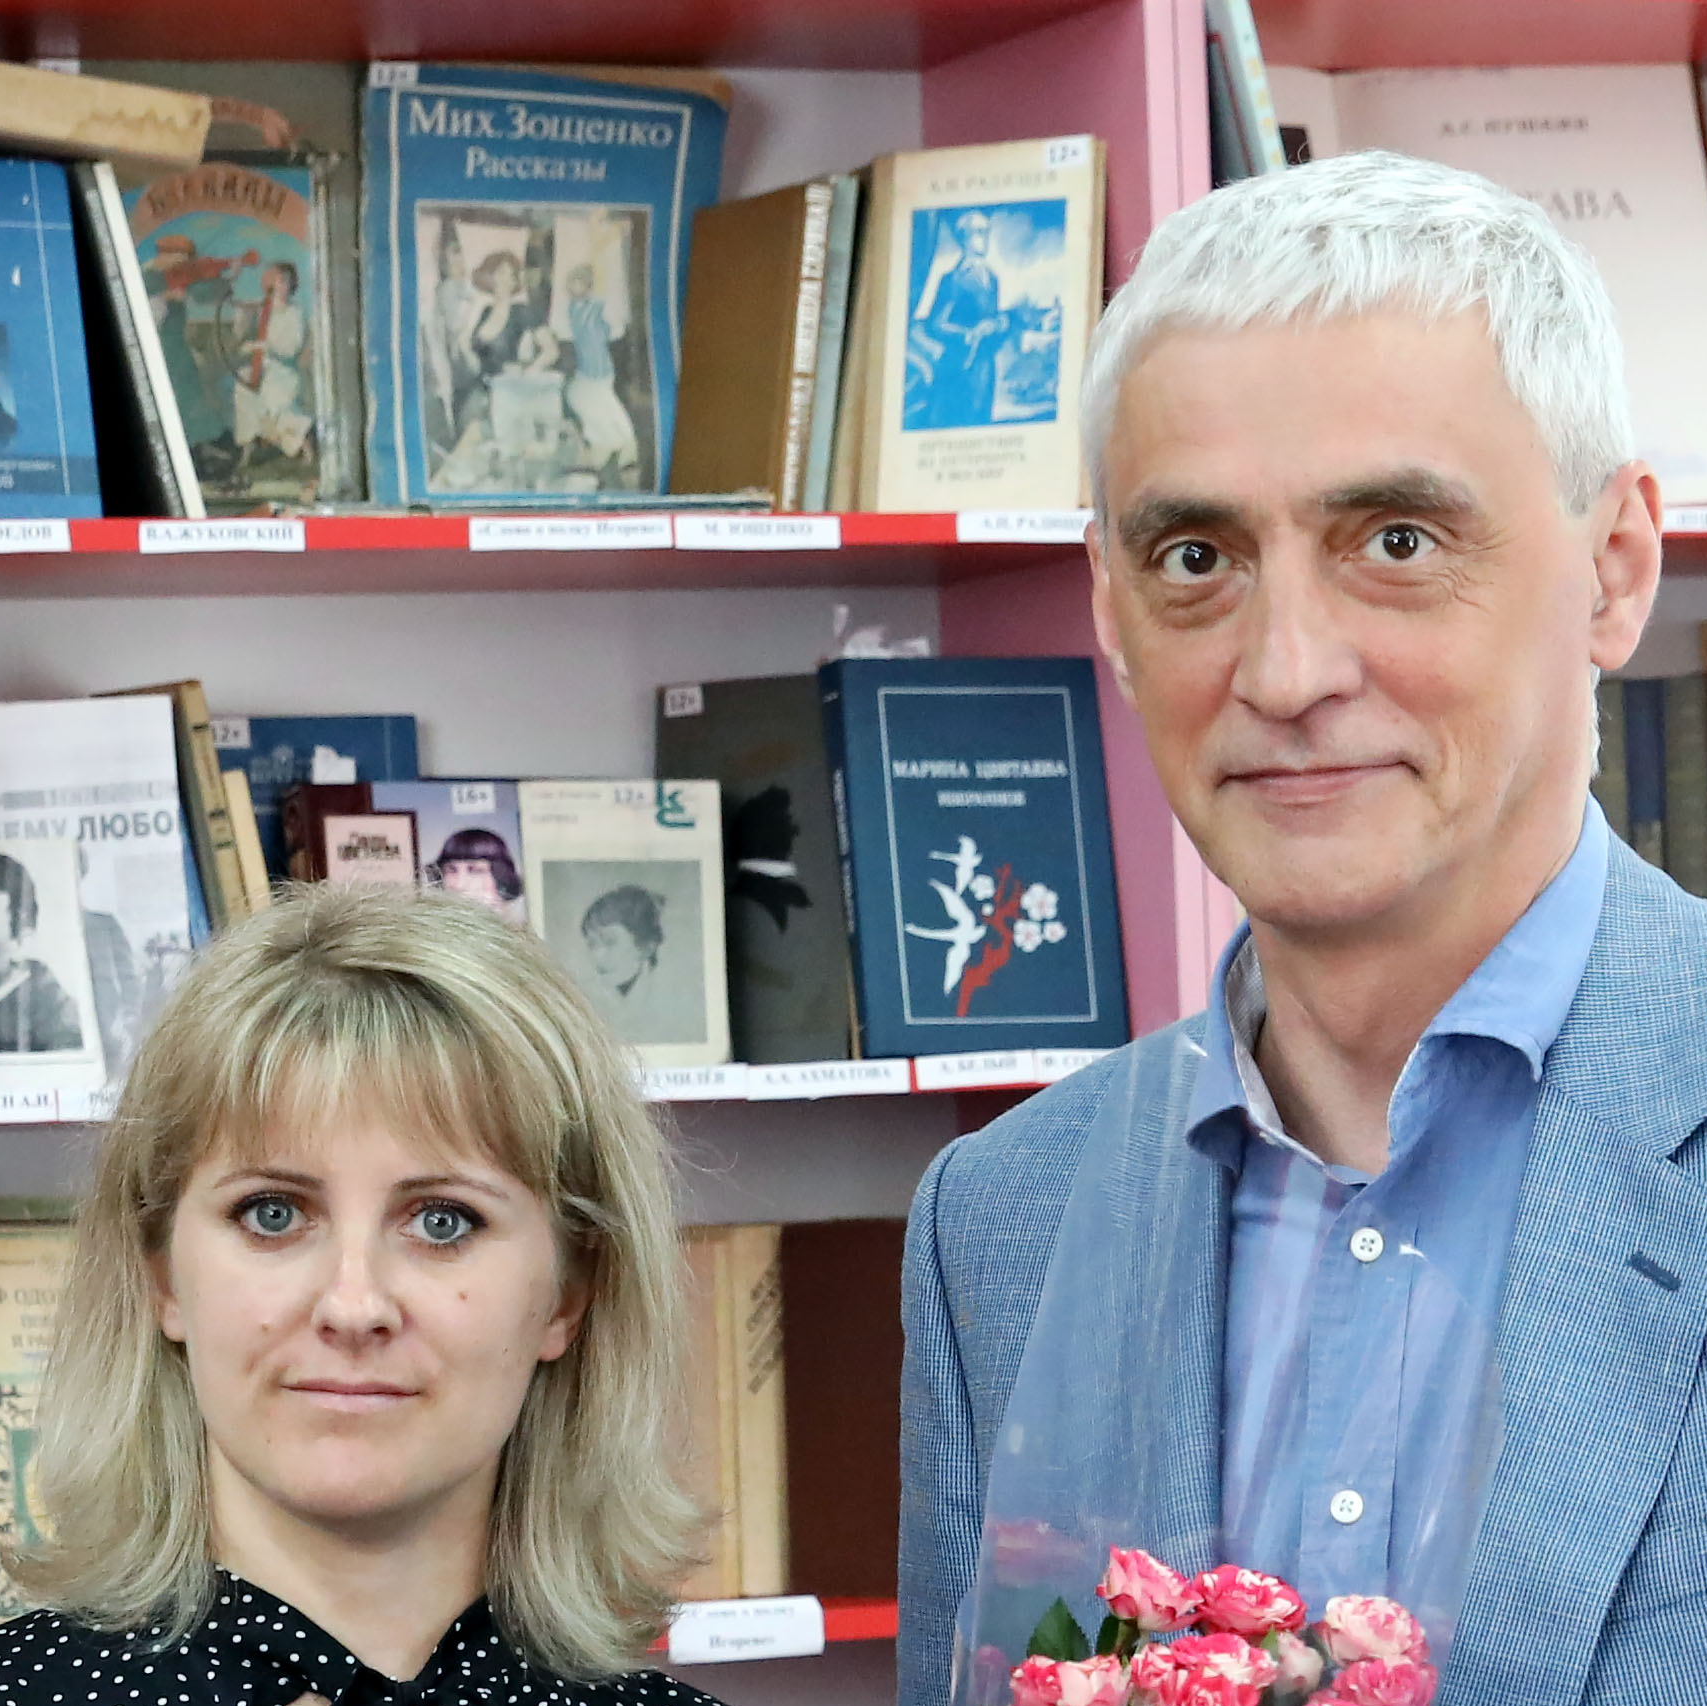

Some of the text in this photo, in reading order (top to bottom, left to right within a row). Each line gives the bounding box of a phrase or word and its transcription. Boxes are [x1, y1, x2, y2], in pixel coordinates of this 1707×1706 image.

[504, 102, 674, 147] Зощенко
[465, 145, 608, 182] Рассказы
[77, 810, 178, 842] ЛЮБО
